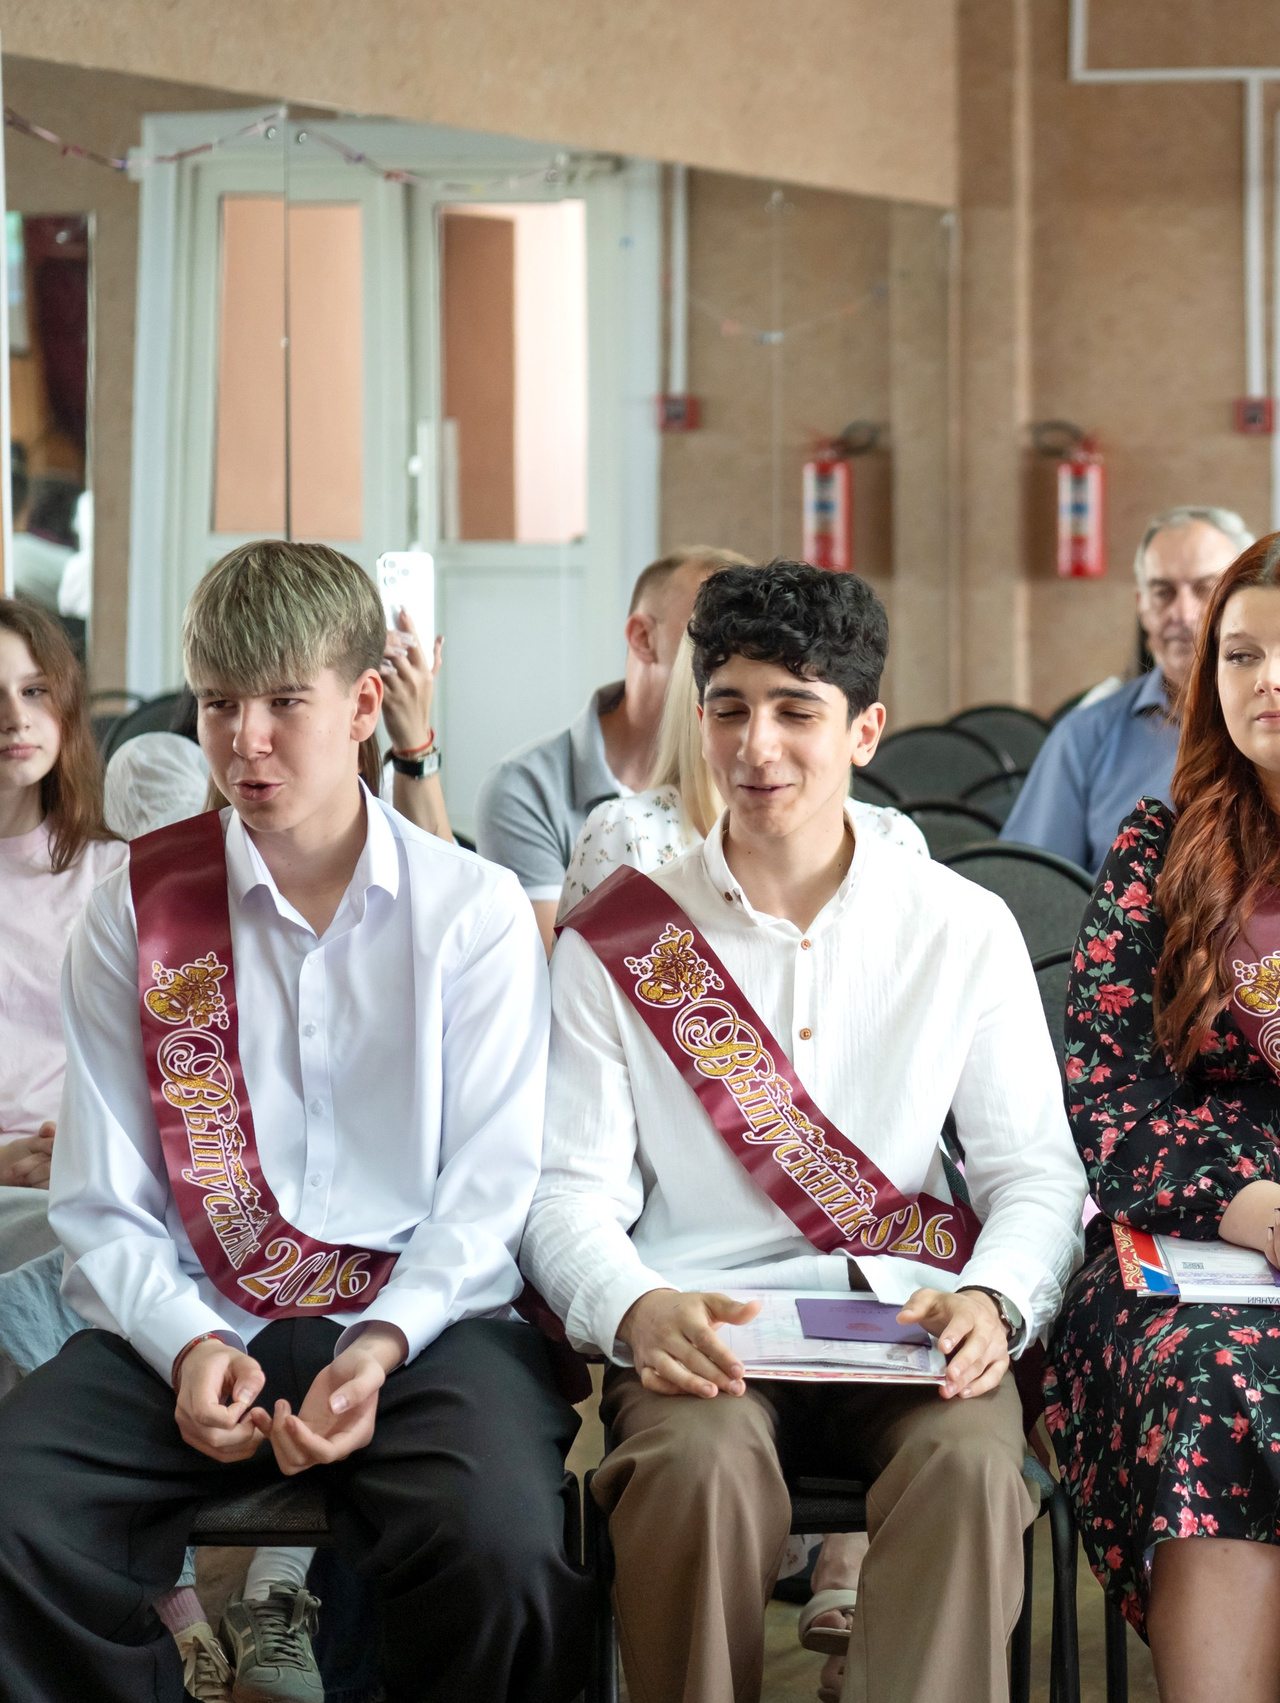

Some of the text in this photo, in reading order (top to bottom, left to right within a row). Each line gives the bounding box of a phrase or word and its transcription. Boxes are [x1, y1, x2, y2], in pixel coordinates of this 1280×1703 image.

[672, 997, 957, 1259] Выпускник 026
[237, 1237, 371, 1306] 2026
